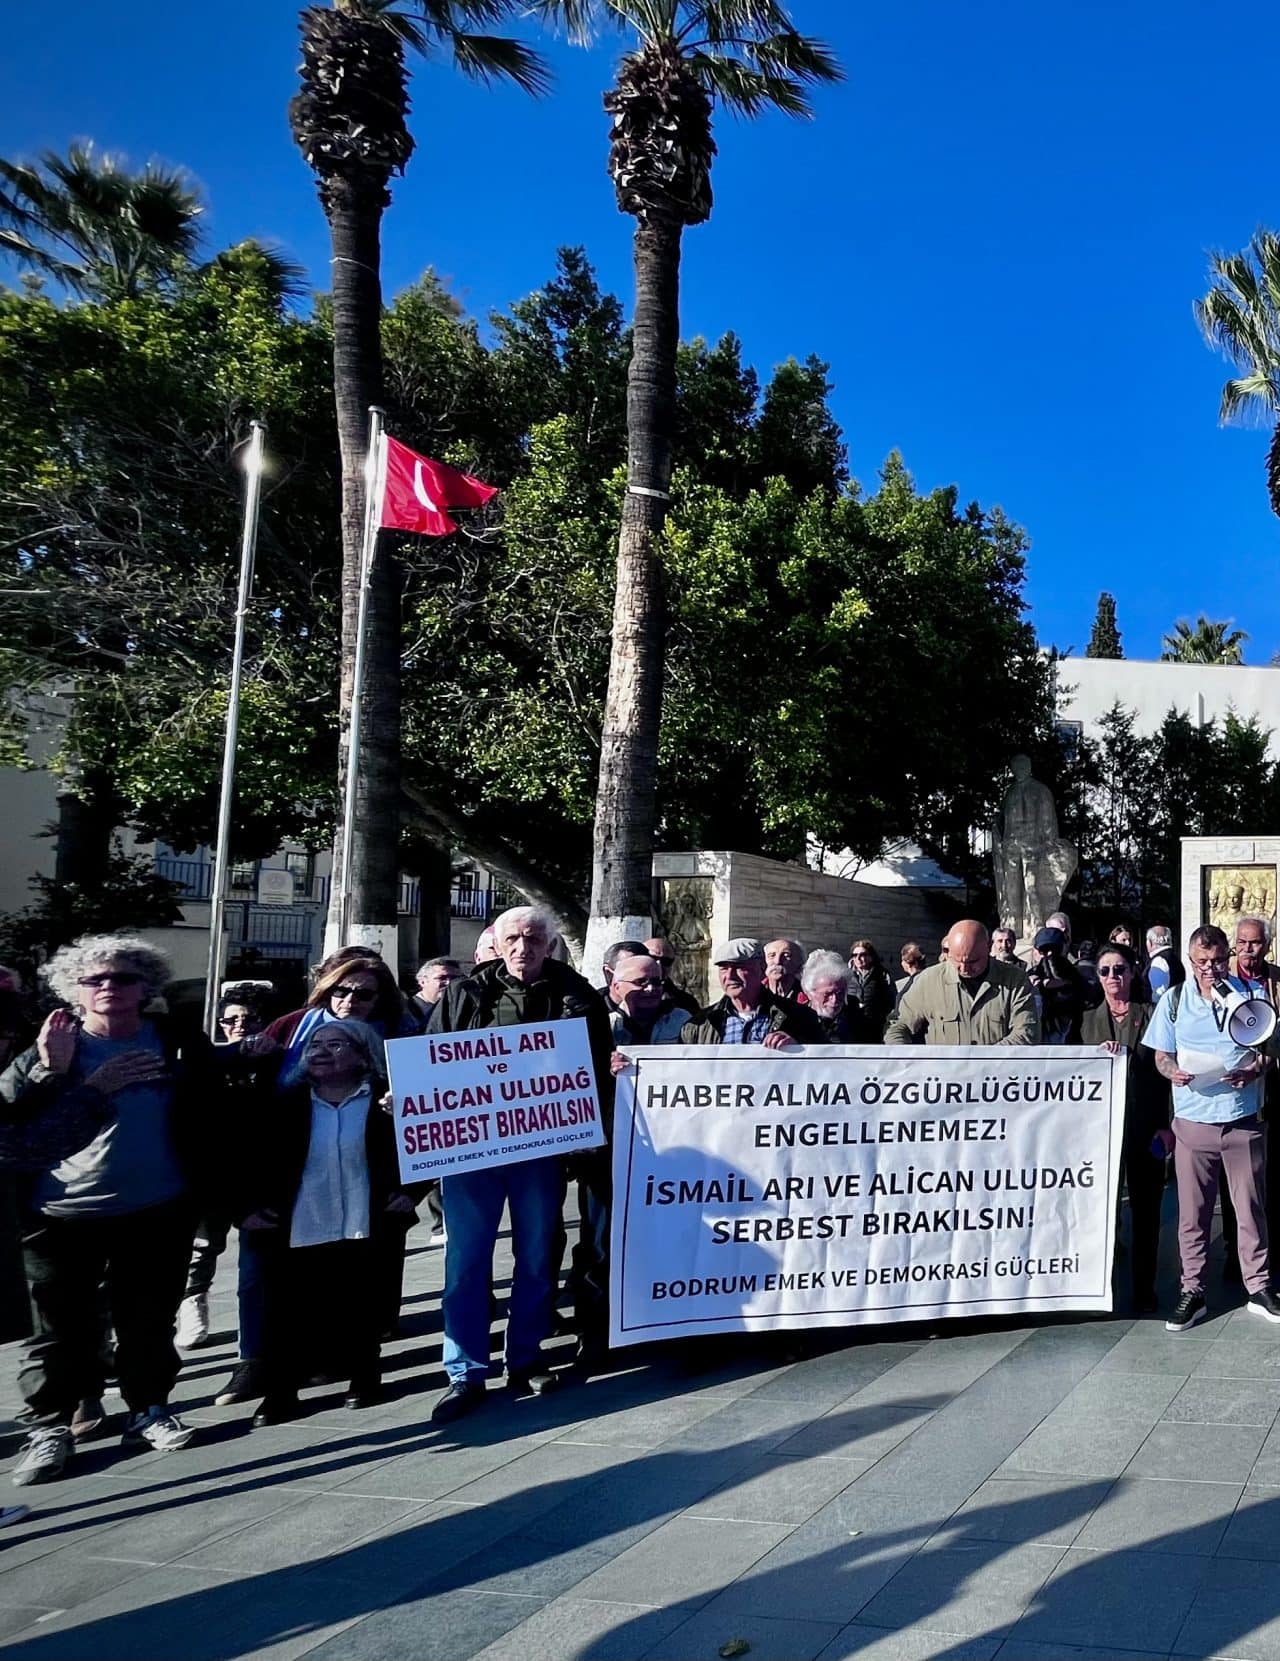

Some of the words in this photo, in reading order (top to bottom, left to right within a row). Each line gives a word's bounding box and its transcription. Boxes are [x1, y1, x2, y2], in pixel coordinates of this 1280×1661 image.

[429, 1033, 511, 1064] İSMAİL
[518, 1031, 555, 1053] ARI
[487, 1062, 508, 1074] ve
[401, 1084, 492, 1117] ALİCAN
[500, 1066, 591, 1101] ULUDAĞ
[647, 1084, 755, 1108] HABER
[763, 1083, 851, 1107] ALMA
[860, 1075, 1103, 1104] ÖZGÜRLÜĞÜMÜZ
[403, 1113, 490, 1155] SERBEST
[496, 1096, 596, 1138] BIRAKILSIN
[755, 1118, 1007, 1147] ENGELLENEMEZ!
[412, 1157, 455, 1171] BODRUM
[458, 1151, 484, 1163] EMEK
[487, 1147, 499, 1156] VE
[501, 1137, 555, 1155] DEMOKRASİ
[557, 1130, 594, 1144] GÜÇLERİ
[645, 1173, 754, 1206] İSMAİL
[762, 1176, 814, 1200] ARI
[824, 1174, 861, 1198] VE
[868, 1166, 974, 1196] ALİCAN
[984, 1161, 1094, 1191] ULUDAĞ
[711, 1214, 853, 1244] SERBEST
[862, 1205, 1034, 1236] BIRAKILSIN!
[652, 1275, 756, 1300] BODRUM
[764, 1271, 825, 1292] EMEK
[831, 1270, 858, 1287] VE
[864, 1257, 988, 1285] DEMOKRASİ
[994, 1254, 1080, 1281] GÜÇLERİ
